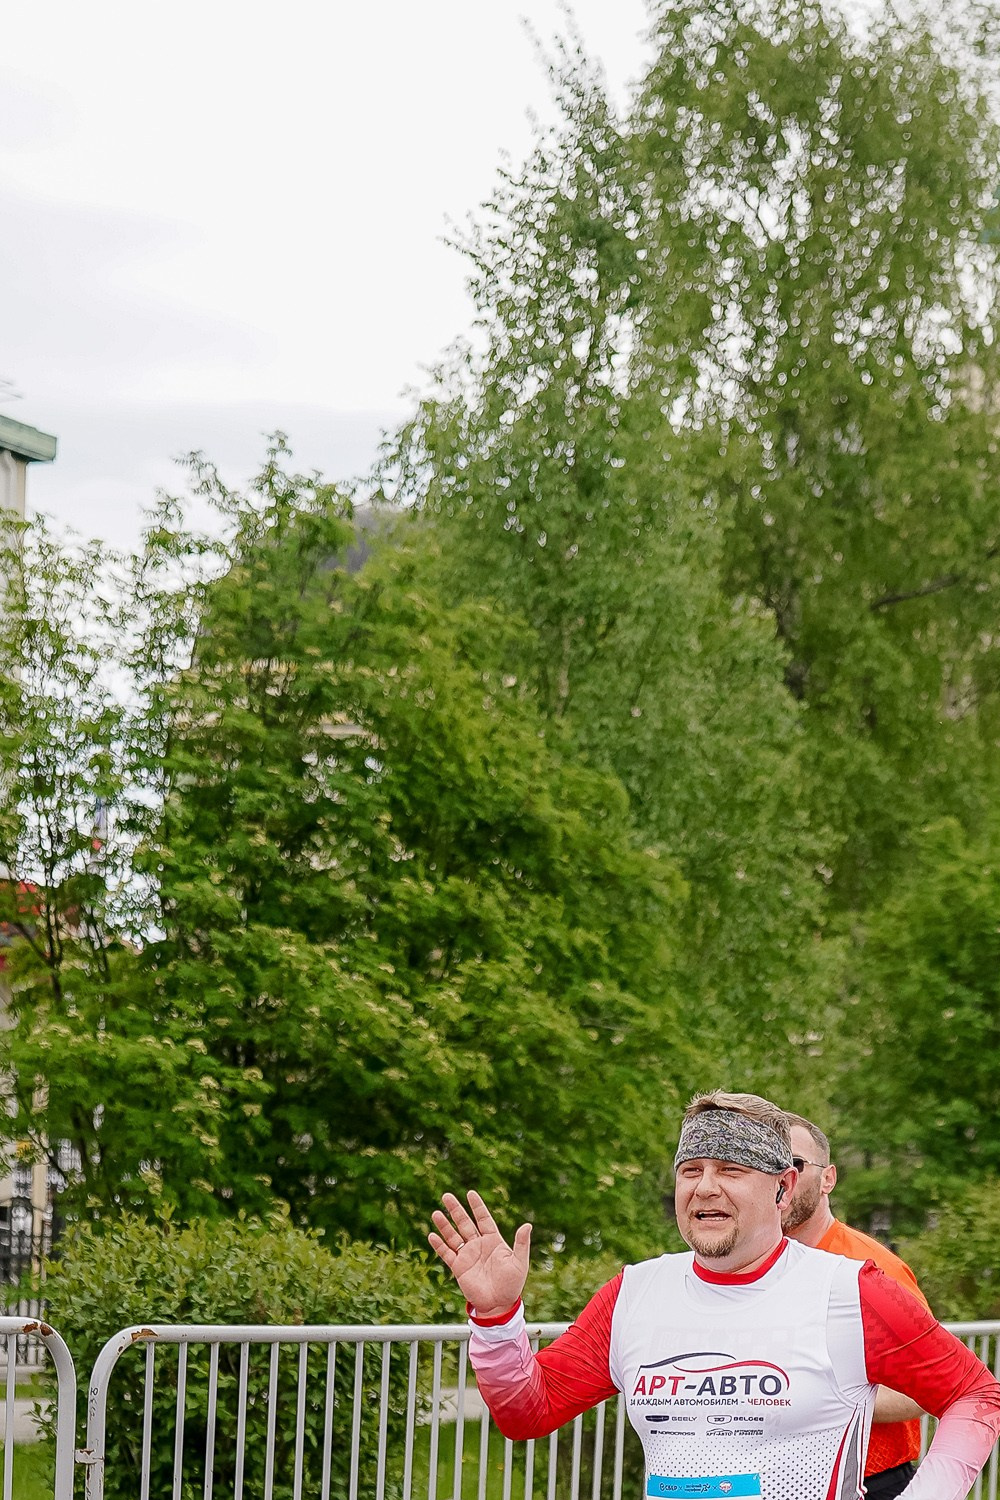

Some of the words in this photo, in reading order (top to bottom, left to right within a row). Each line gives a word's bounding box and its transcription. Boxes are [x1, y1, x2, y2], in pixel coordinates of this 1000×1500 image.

[633, 1374, 782, 1396] АРТ-АВТО
[637, 1398, 672, 1407] КАЖДЫМ
[673, 1398, 739, 1407] АВТОМОБИЛЕМ
[747, 1398, 792, 1407] ЧЕЛОВЕК
